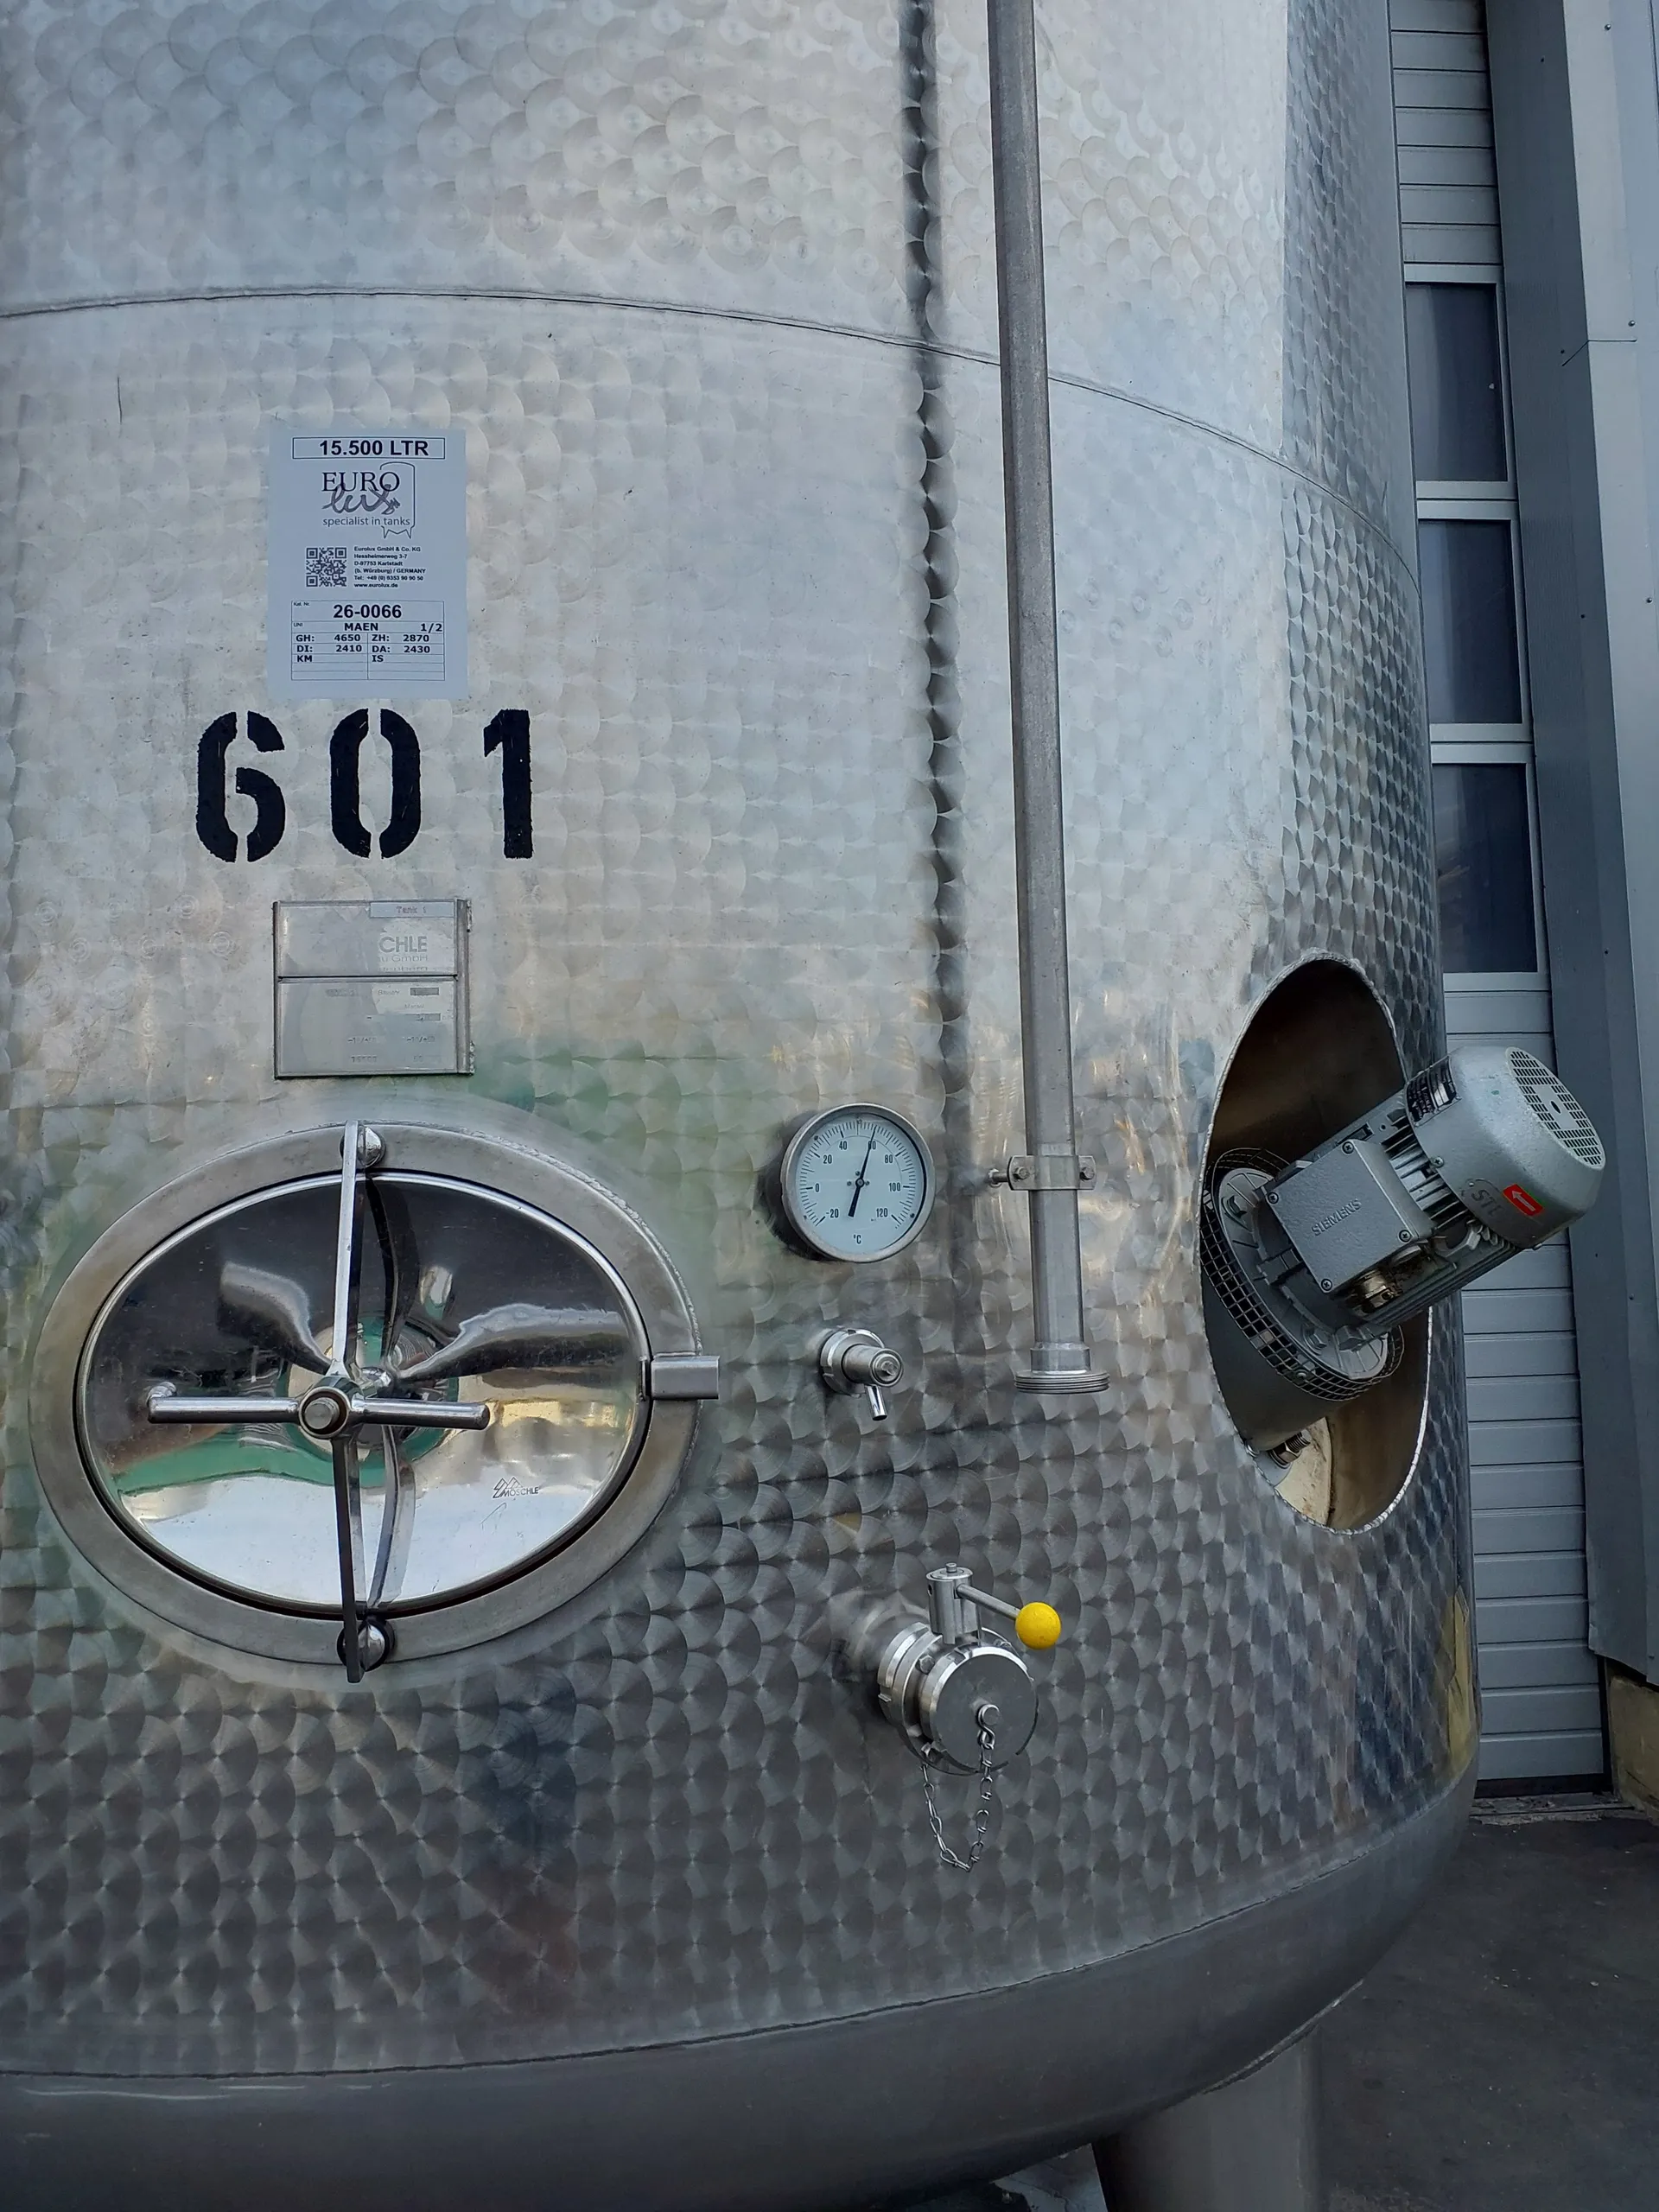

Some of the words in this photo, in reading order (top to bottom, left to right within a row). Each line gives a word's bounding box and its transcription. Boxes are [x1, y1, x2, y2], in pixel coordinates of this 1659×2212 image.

[319, 439, 384, 456] 15.500
[390, 440, 429, 456] LTR
[321, 471, 401, 493] EURO
[322, 516, 370, 528] specialist
[371, 516, 382, 526] in
[383, 516, 411, 526] tanks
[333, 604, 403, 619] 26-0066
[344, 622, 379, 632] MAEN
[420, 622, 443, 634] 1/2
[296, 634, 315, 643] GH:
[334, 633, 361, 643] 4650
[403, 634, 429, 643] 2870
[296, 645, 314, 653] DI:
[335, 644, 363, 653] 2410
[372, 645, 391, 654] DA:
[404, 645, 431, 654] 2430
[838, 1141, 848, 1151] 40
[868, 1141, 877, 1151] 60
[823, 1154, 833, 1165] 20
[884, 1154, 893, 1164] 80
[815, 1183, 820, 1192] 0
[888, 1182, 901, 1192] 100
[875, 1207, 888, 1218] 120
[1311, 1198, 1363, 1236] SIEMENS
